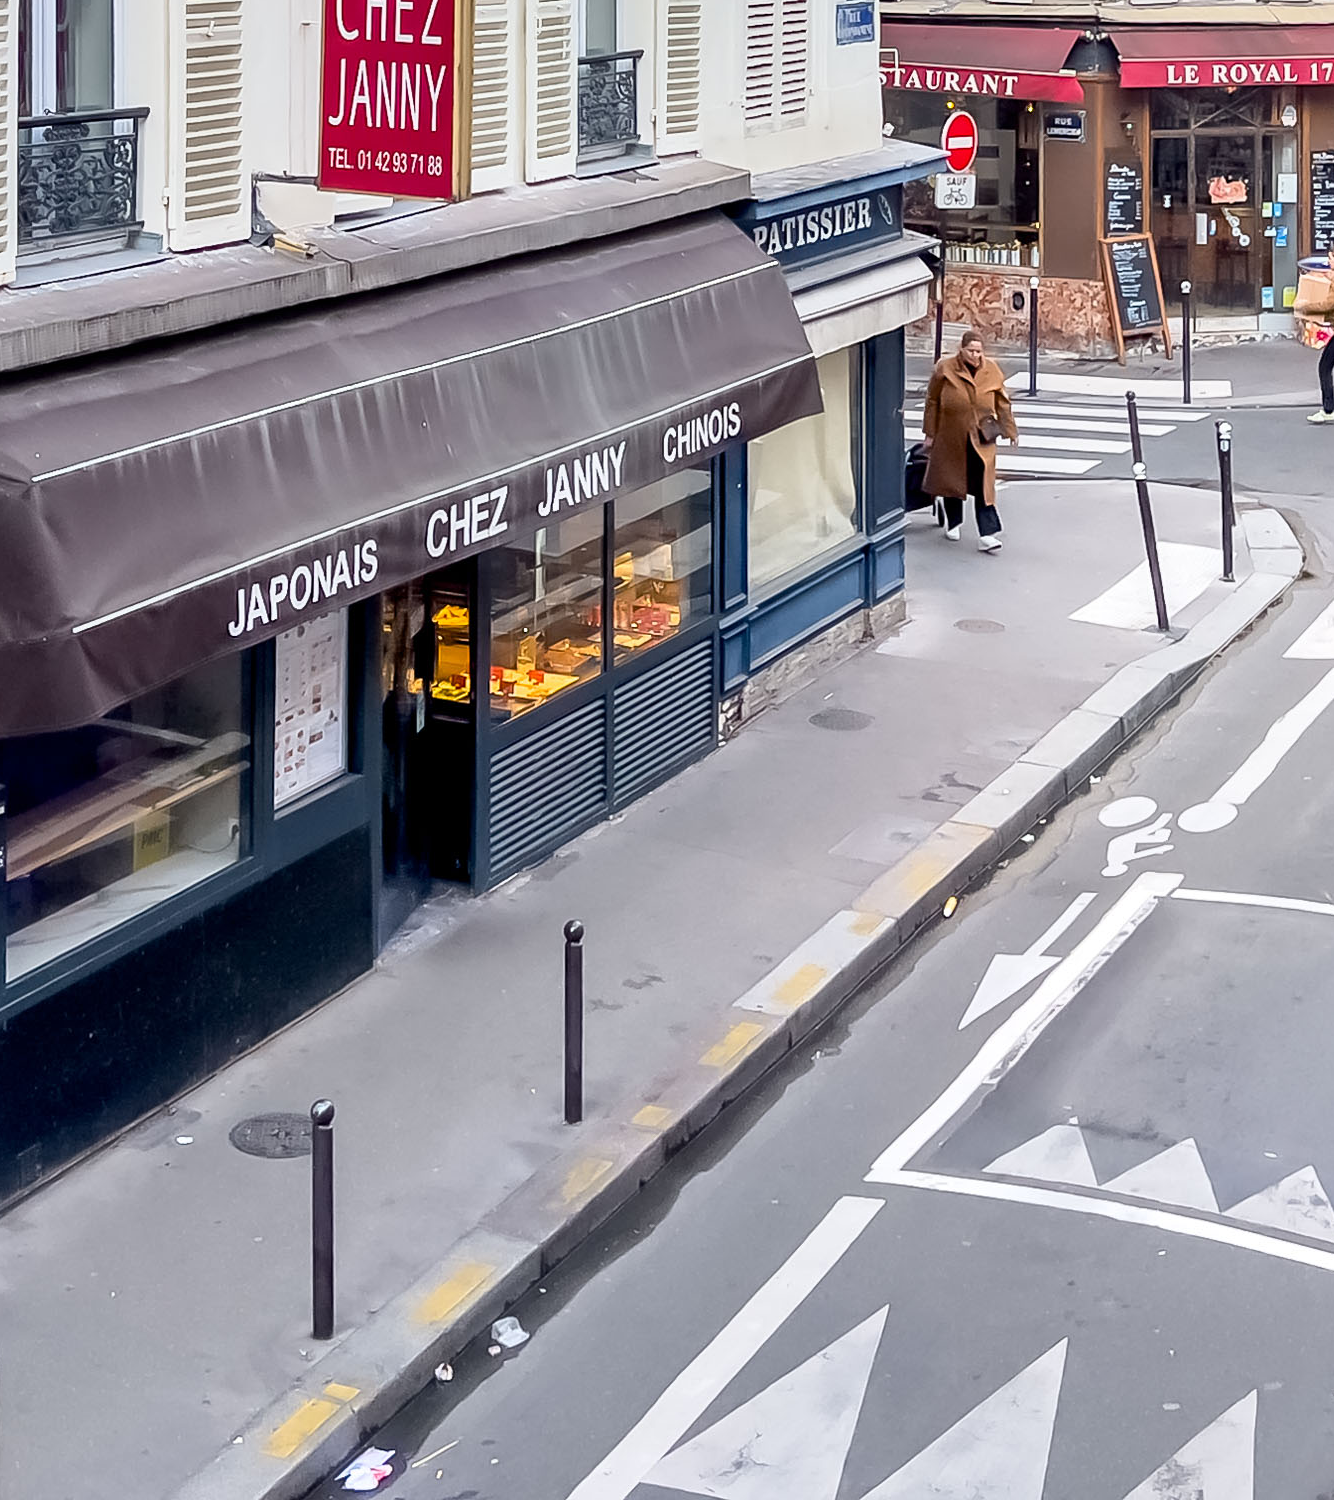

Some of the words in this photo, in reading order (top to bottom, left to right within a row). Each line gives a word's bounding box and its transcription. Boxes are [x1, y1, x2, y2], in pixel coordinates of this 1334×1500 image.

[1167, 64, 1200, 84] LE
[1212, 63, 1298, 84] ROYAL
[1310, 62, 1334, 82] 17
[328, 58, 447, 132] JANNY
[328, 147, 355, 169] TEL.
[357, 150, 372, 170] 01
[375, 151, 390, 172] 42
[392, 152, 408, 174] 93
[410, 153, 424, 175] 71
[427, 155, 443, 176] 88
[946, 177, 967, 186] SAUF
[753, 198, 872, 255] PATISSIER
[227, 538, 379, 638] JAPONAIS
[425, 485, 509, 558] CHEZ
[537, 442, 626, 518] JANNY
[662, 402, 742, 464] CHINOIS
